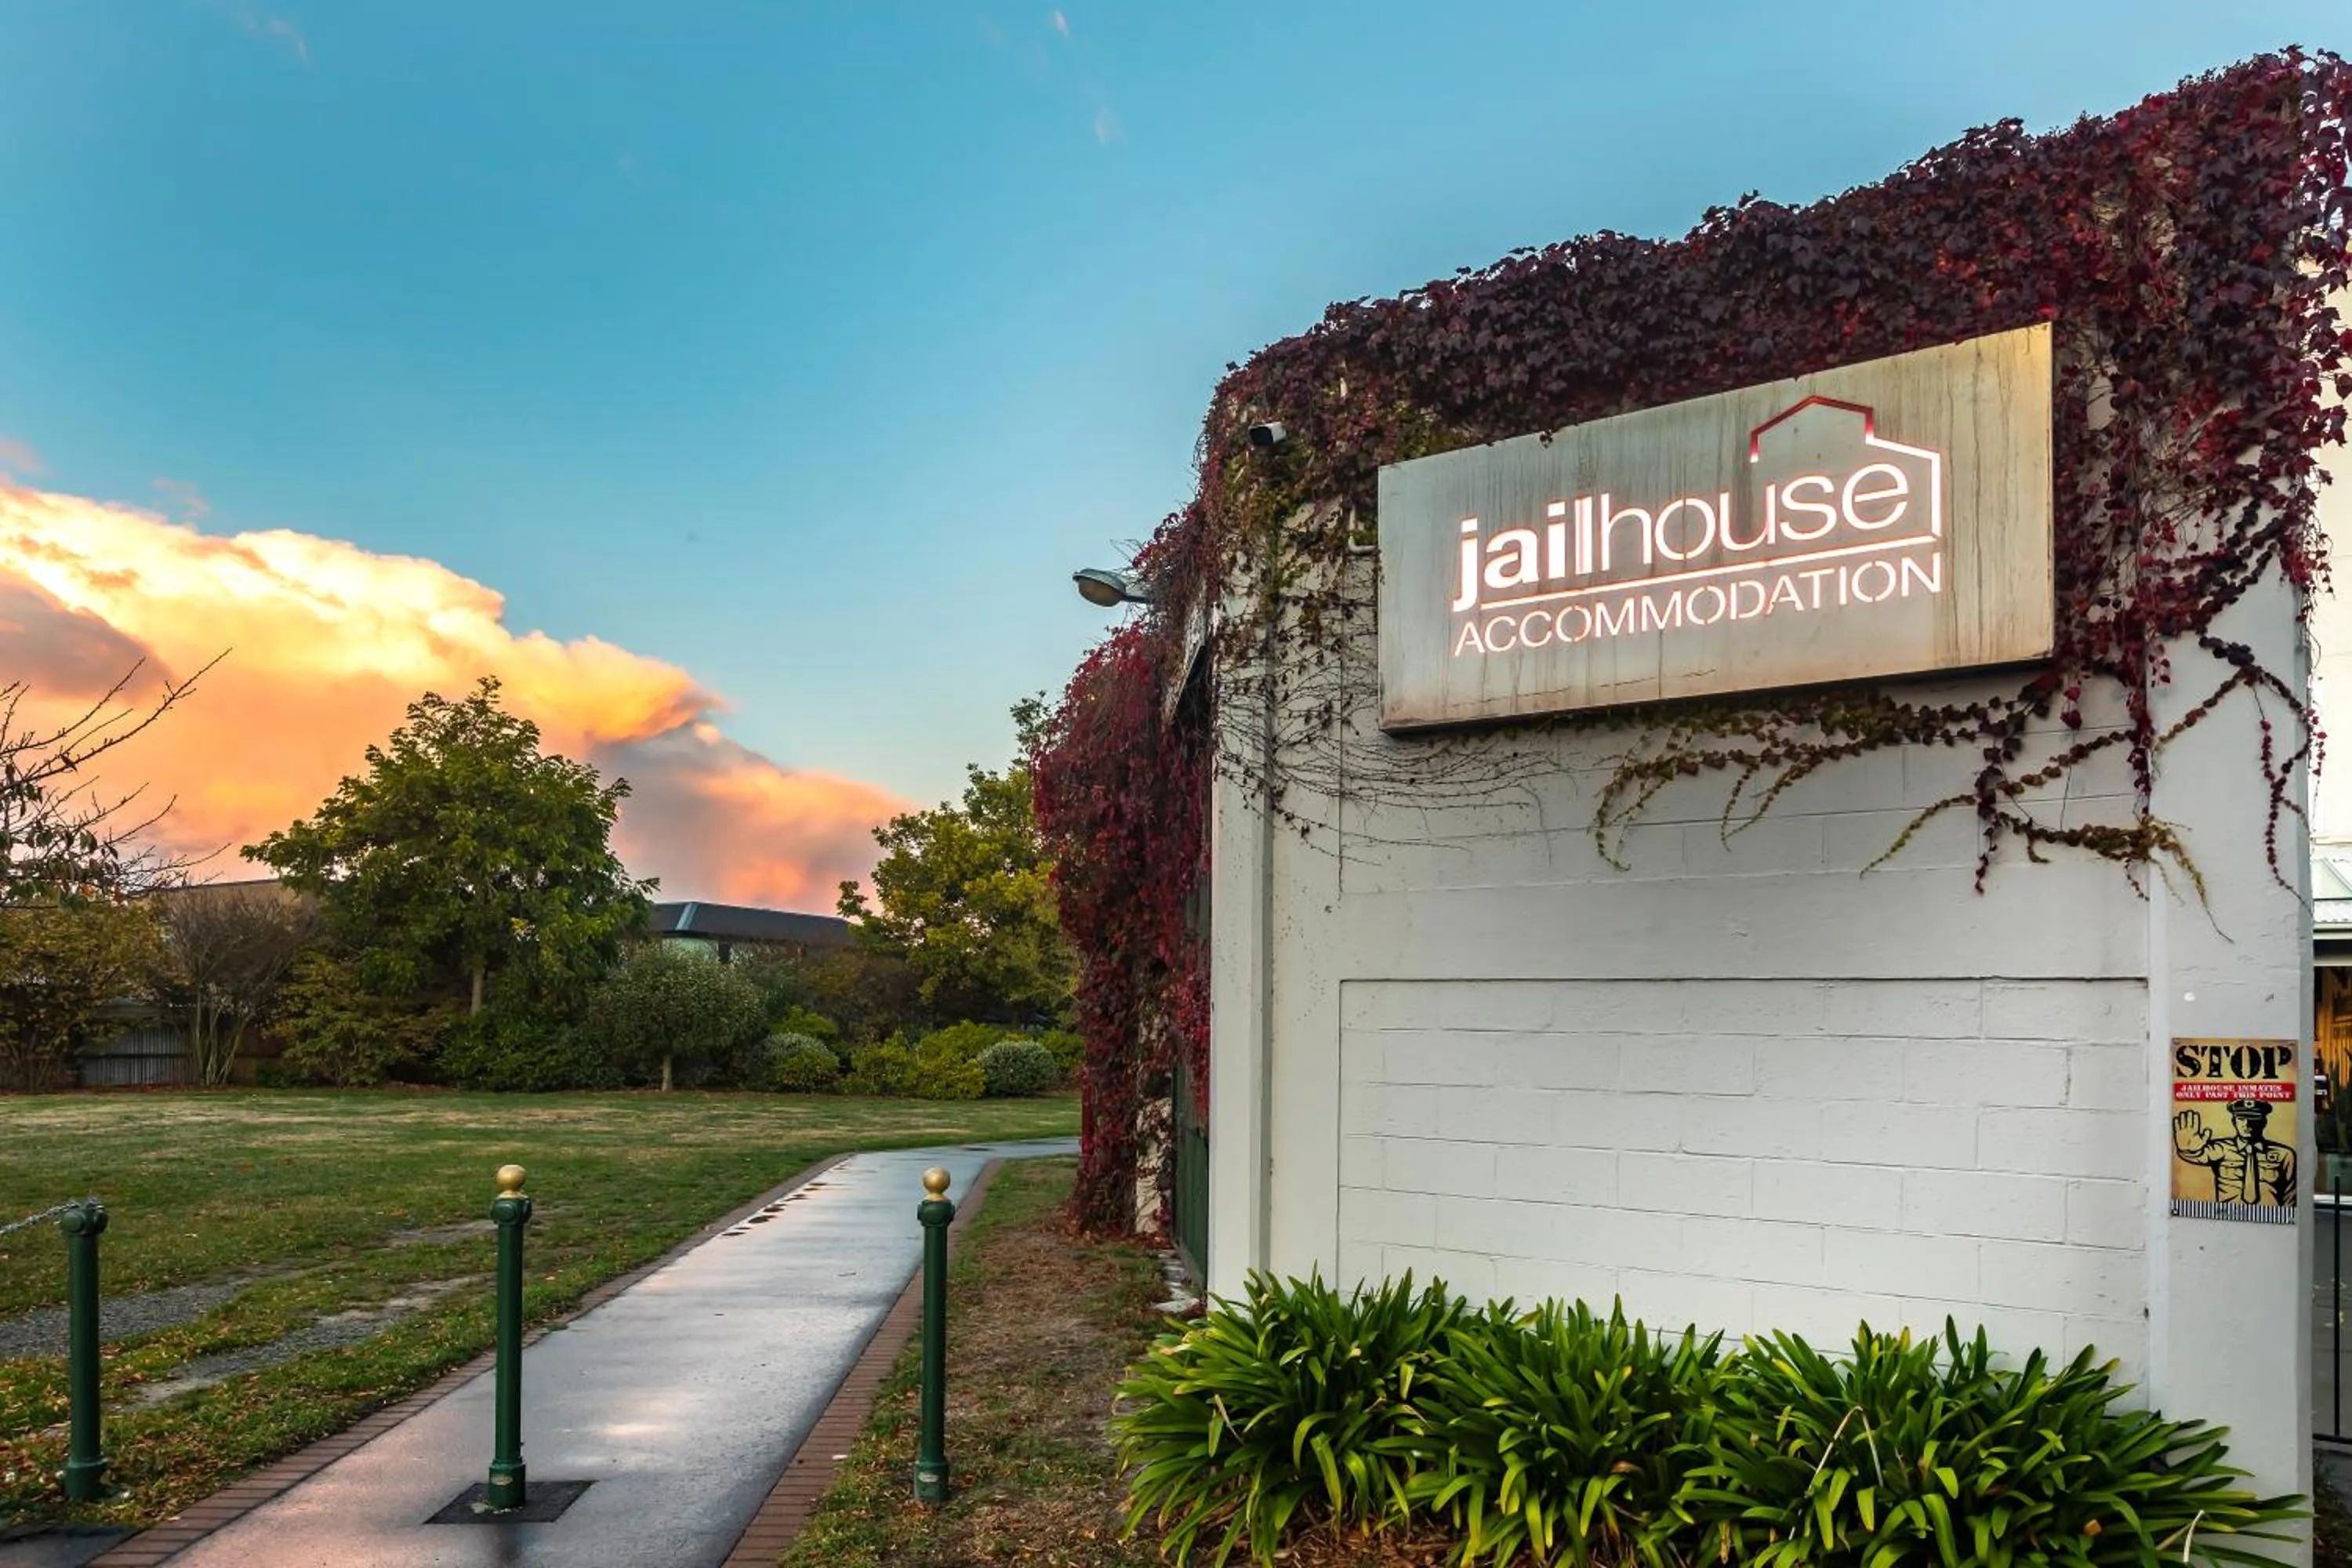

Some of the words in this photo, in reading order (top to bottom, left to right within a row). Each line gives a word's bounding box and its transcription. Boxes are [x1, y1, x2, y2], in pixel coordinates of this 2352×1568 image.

[1453, 463, 1909, 612] jailhouse
[1454, 552, 1941, 656] ACCOMMODATION
[2176, 1045, 2292, 1079] STOP
